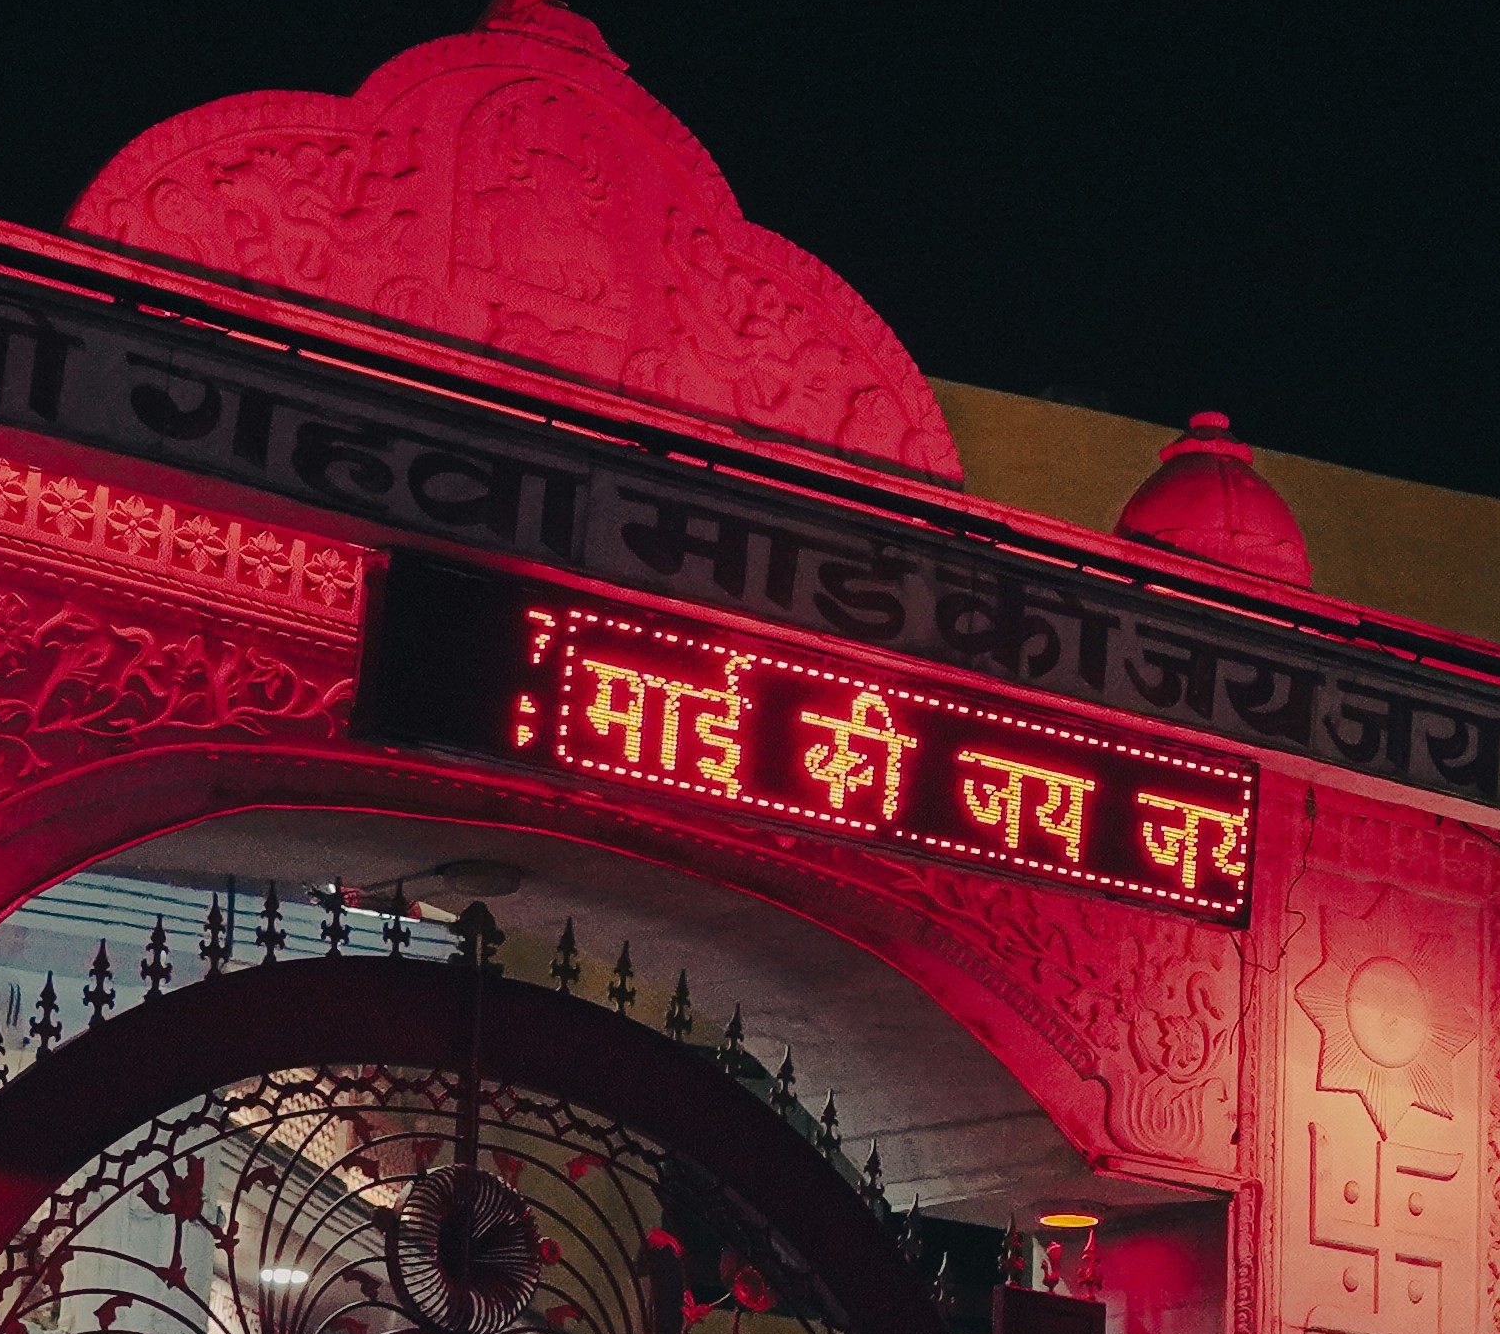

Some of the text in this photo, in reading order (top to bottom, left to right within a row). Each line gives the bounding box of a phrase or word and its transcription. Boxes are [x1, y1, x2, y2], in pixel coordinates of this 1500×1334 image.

[127, 353, 585, 569] गहवा
[1123, 622, 1327, 748] जय
[582, 654, 753, 799] माई
[799, 689, 918, 820] की
[958, 749, 1096, 862] जय
